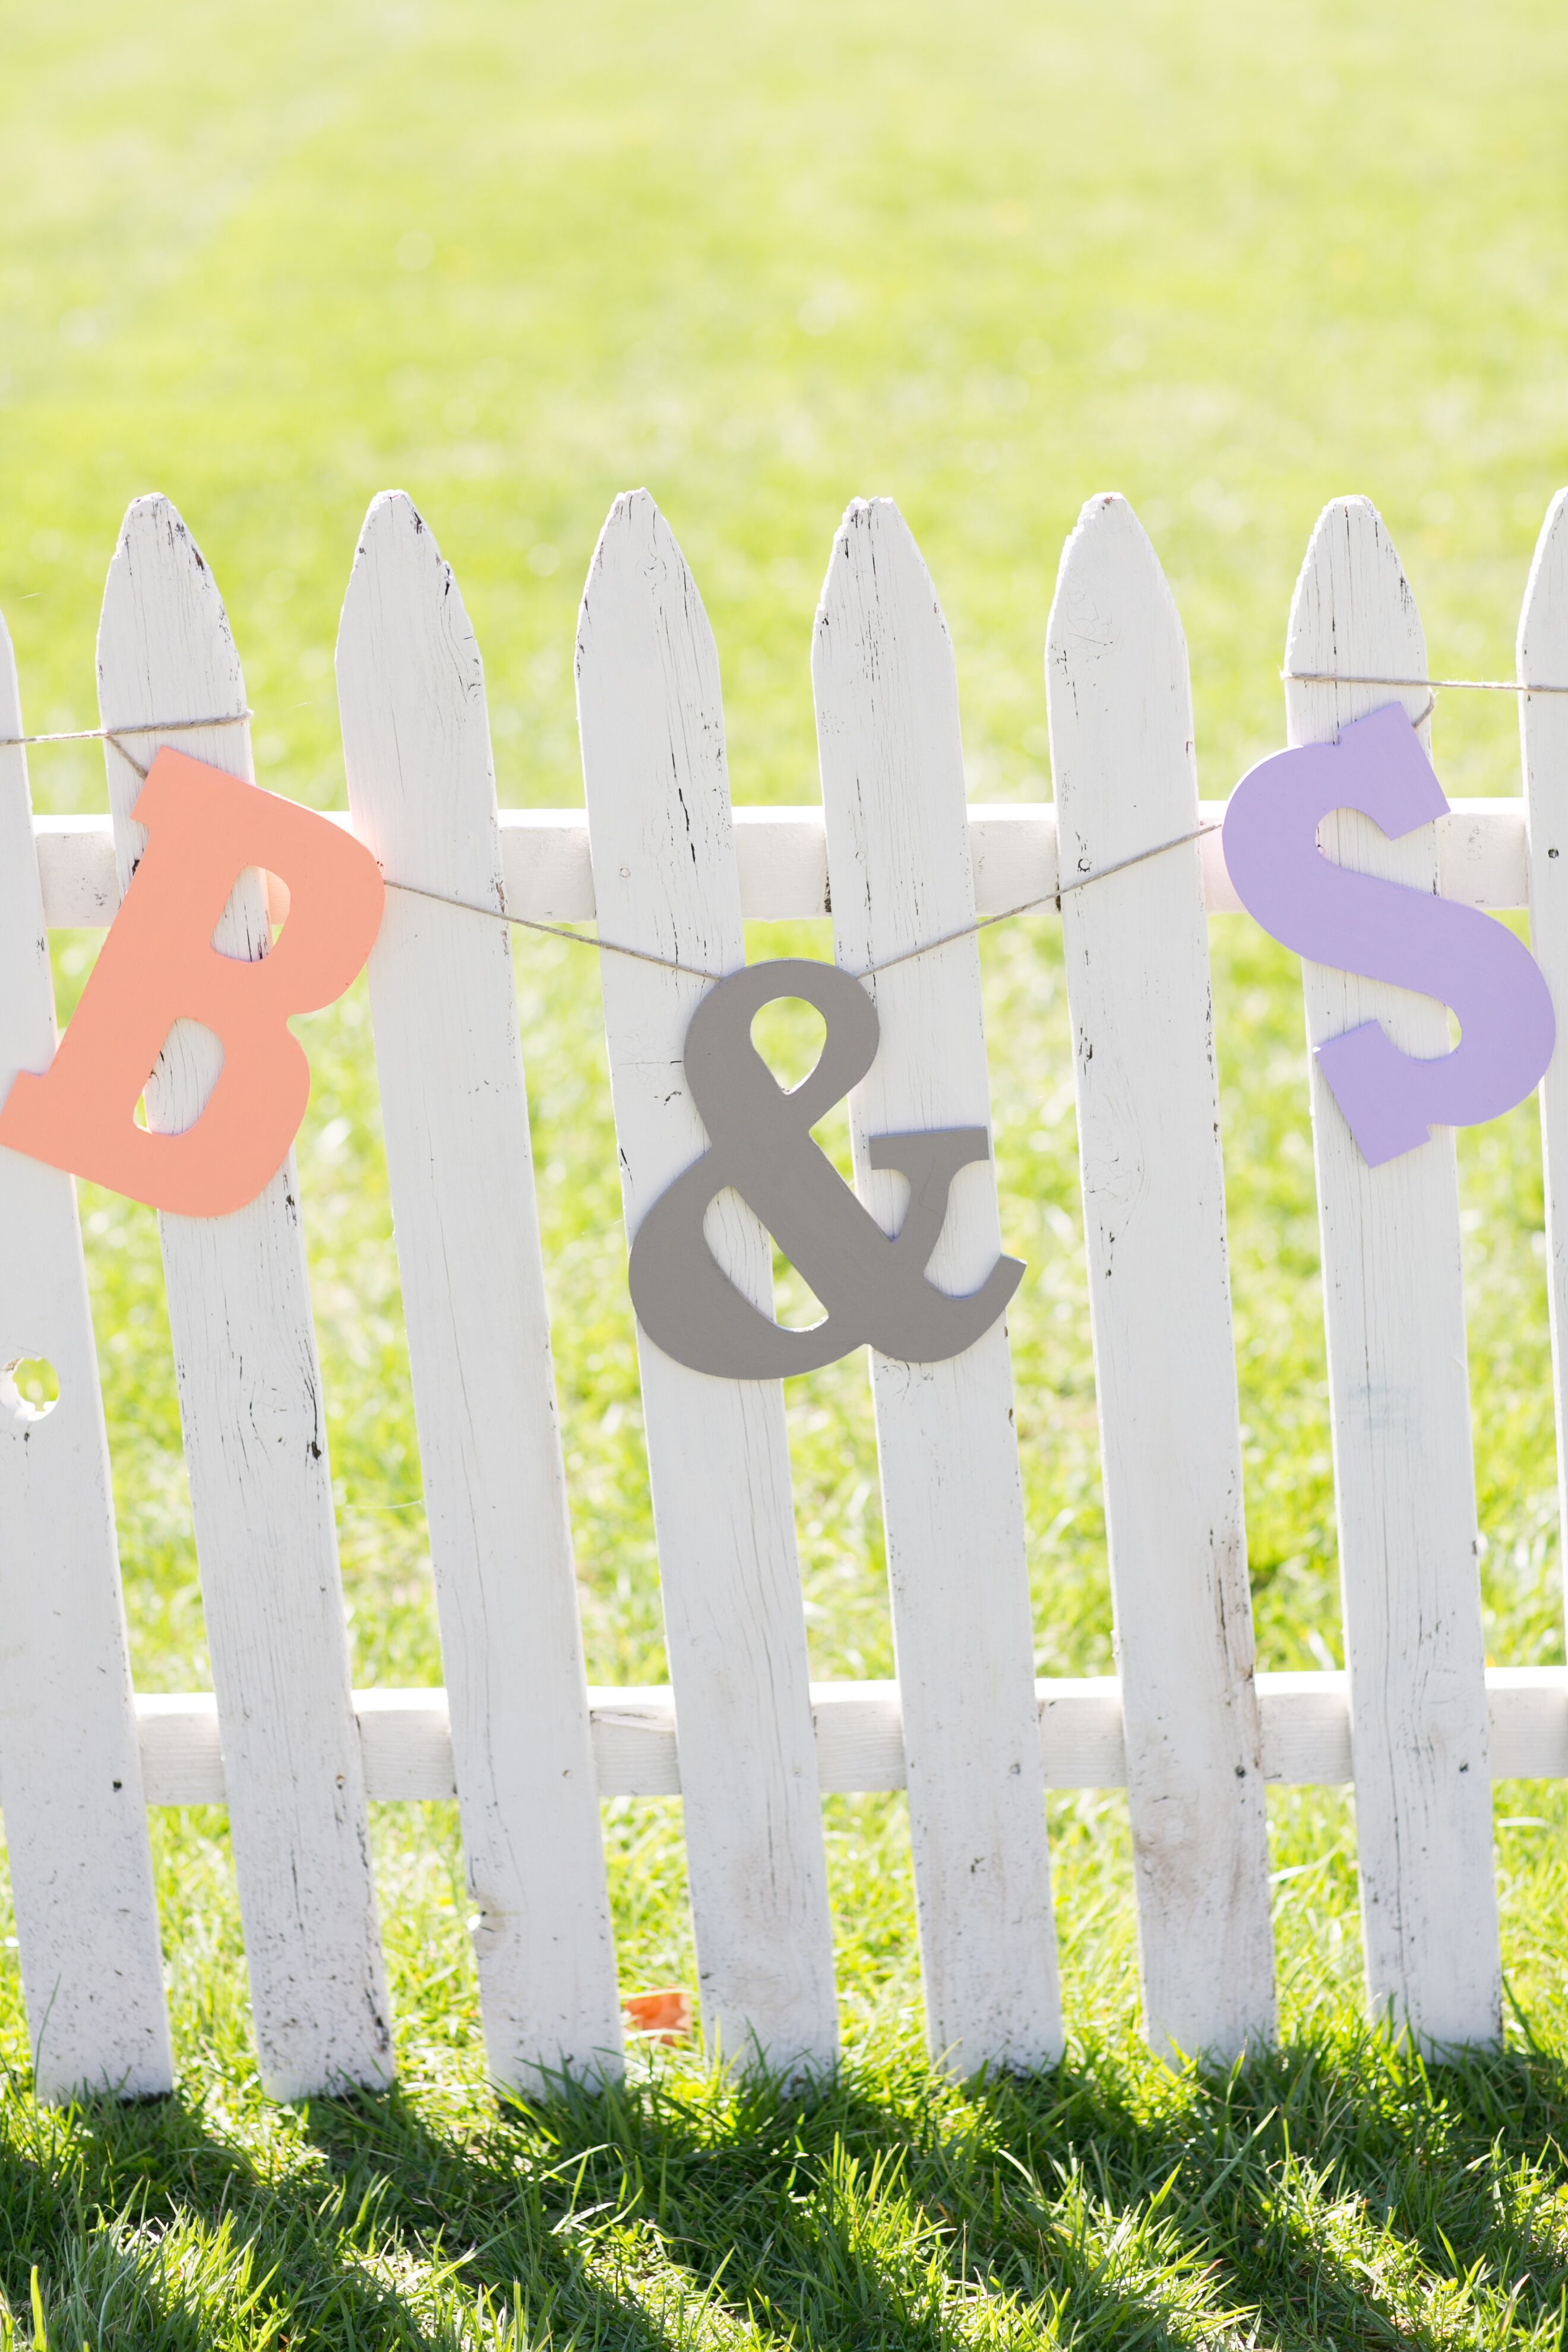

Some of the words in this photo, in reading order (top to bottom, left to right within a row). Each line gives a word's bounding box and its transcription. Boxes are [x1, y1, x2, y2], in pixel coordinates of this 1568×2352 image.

[0, 746, 385, 1217] B
[628, 958, 1027, 1380] &
[1222, 701, 1556, 1168] S
